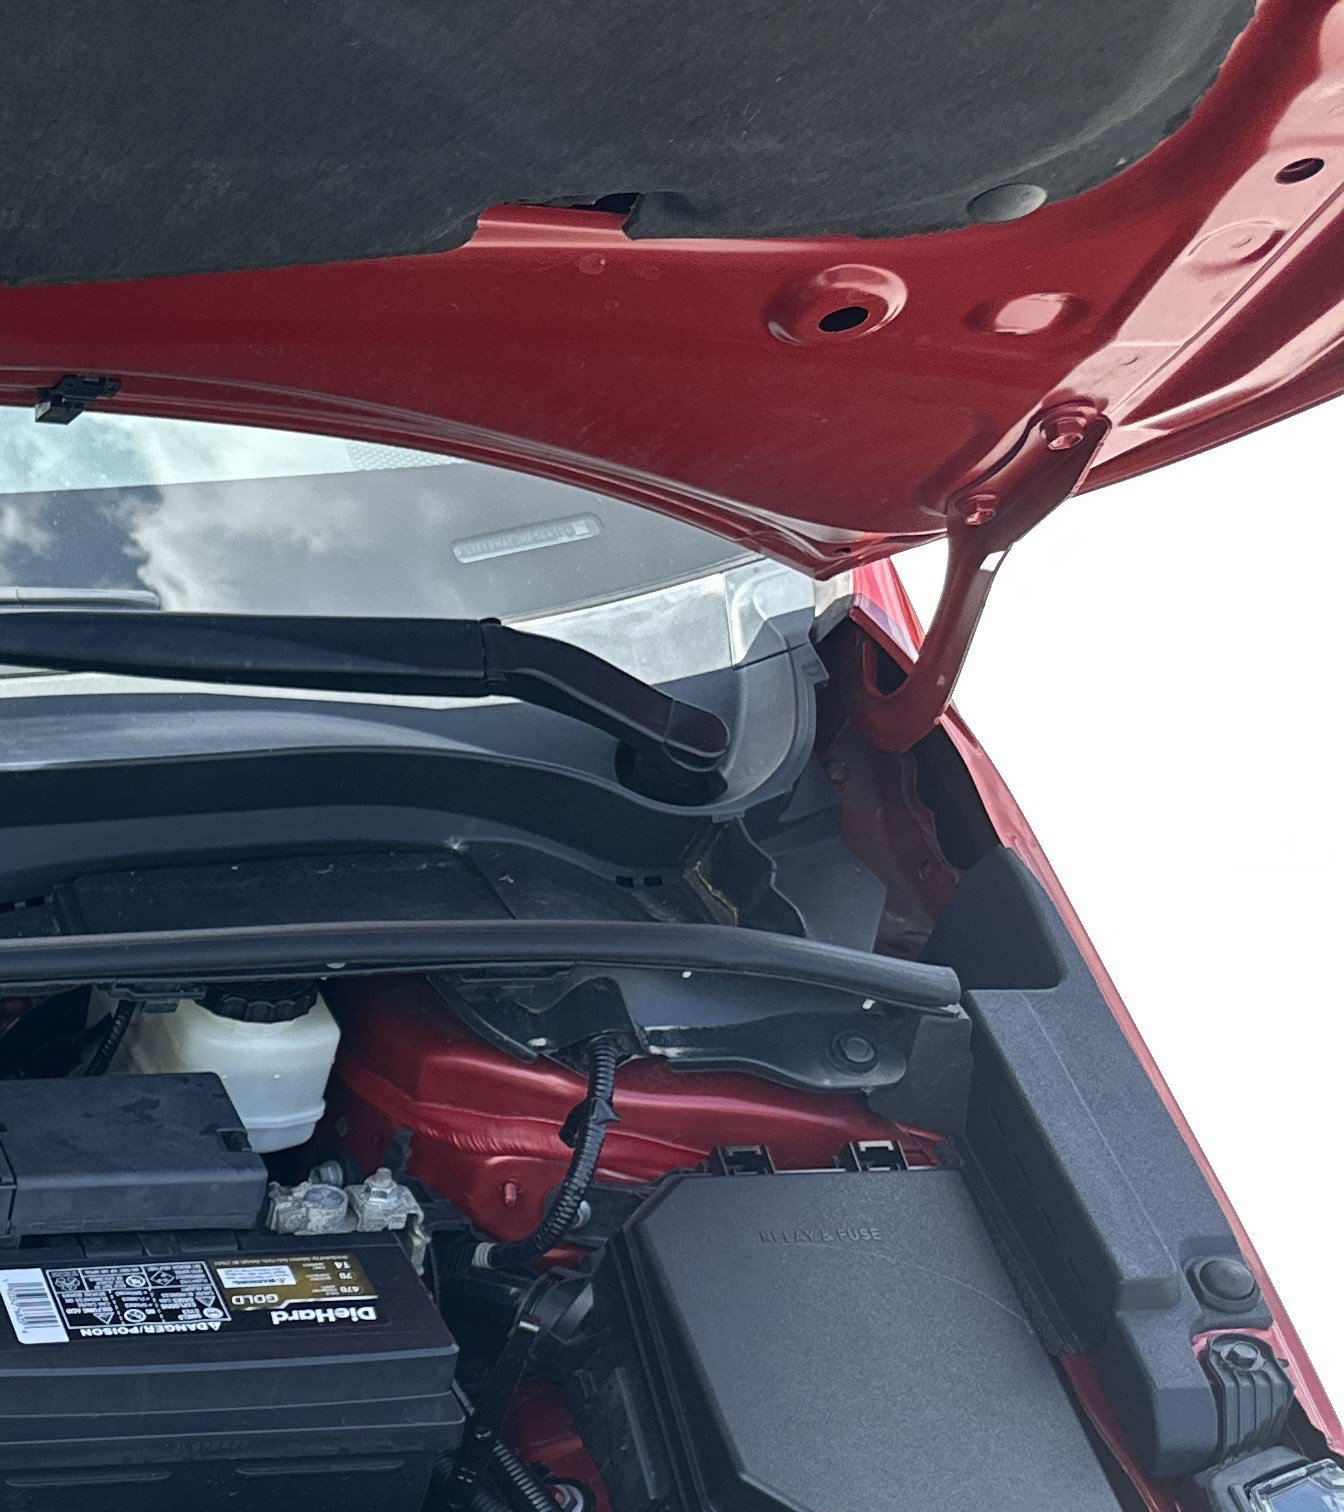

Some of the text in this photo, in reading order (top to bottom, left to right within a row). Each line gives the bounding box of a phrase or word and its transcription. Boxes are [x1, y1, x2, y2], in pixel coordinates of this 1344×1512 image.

[835, 1227, 883, 1242] FUSE
[231, 1293, 279, 1305] GOLD
[270, 1306, 377, 1325] DieHard
[80, 1321, 209, 1337] DANGER/POISON
